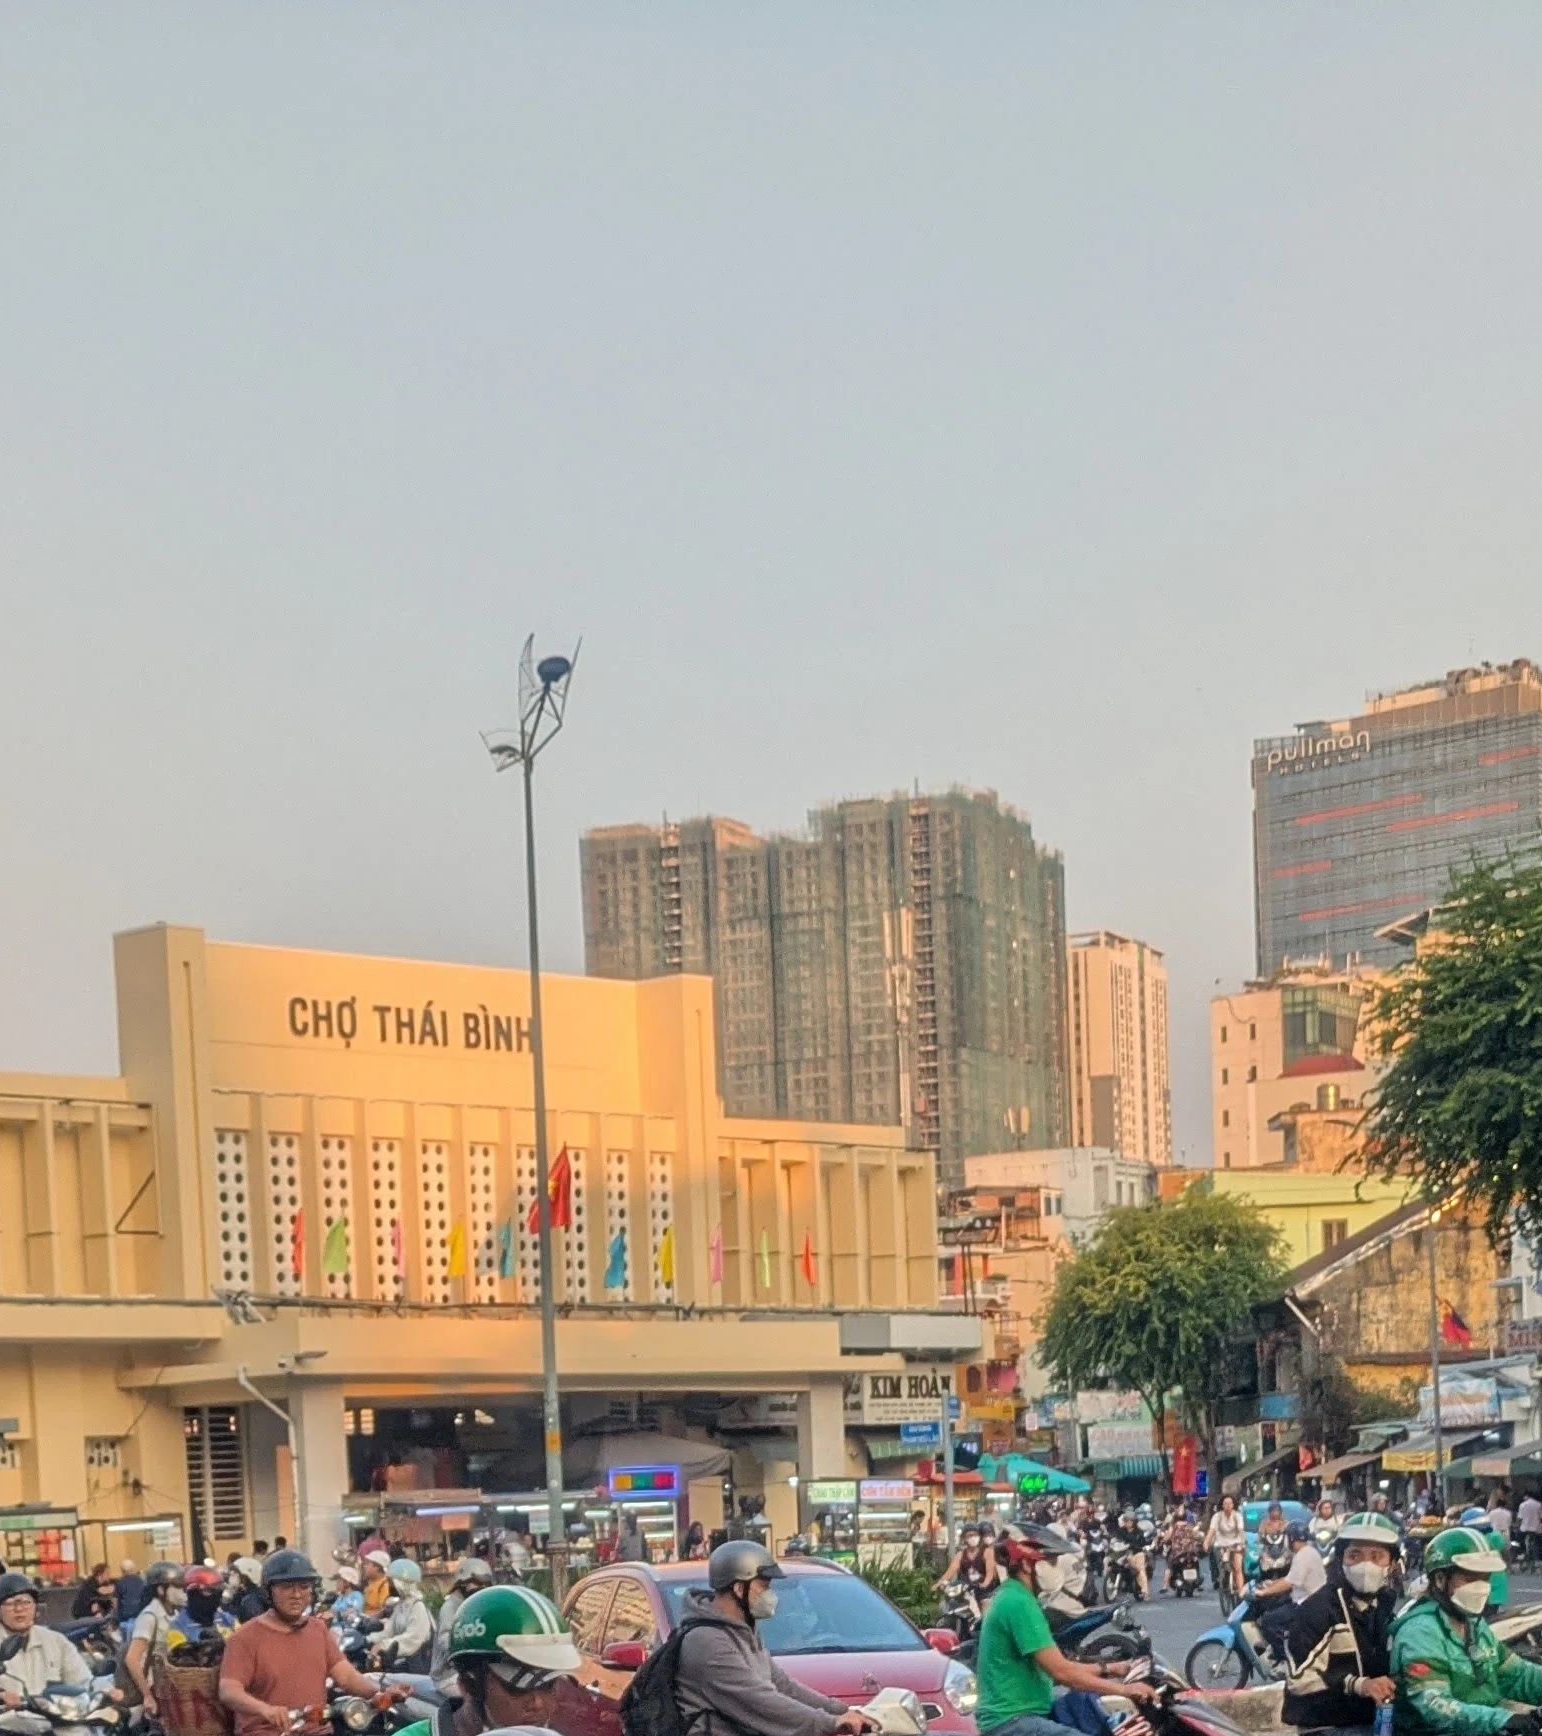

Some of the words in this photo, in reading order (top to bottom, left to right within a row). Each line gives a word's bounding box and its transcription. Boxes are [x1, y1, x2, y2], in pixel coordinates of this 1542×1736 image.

[1267, 731, 1371, 771] pullman
[289, 996, 357, 1049] CHỢ
[373, 1000, 448, 1047] THÁI
[463, 1004, 533, 1054] BÌNH
[870, 1375, 902, 1398] KIM
